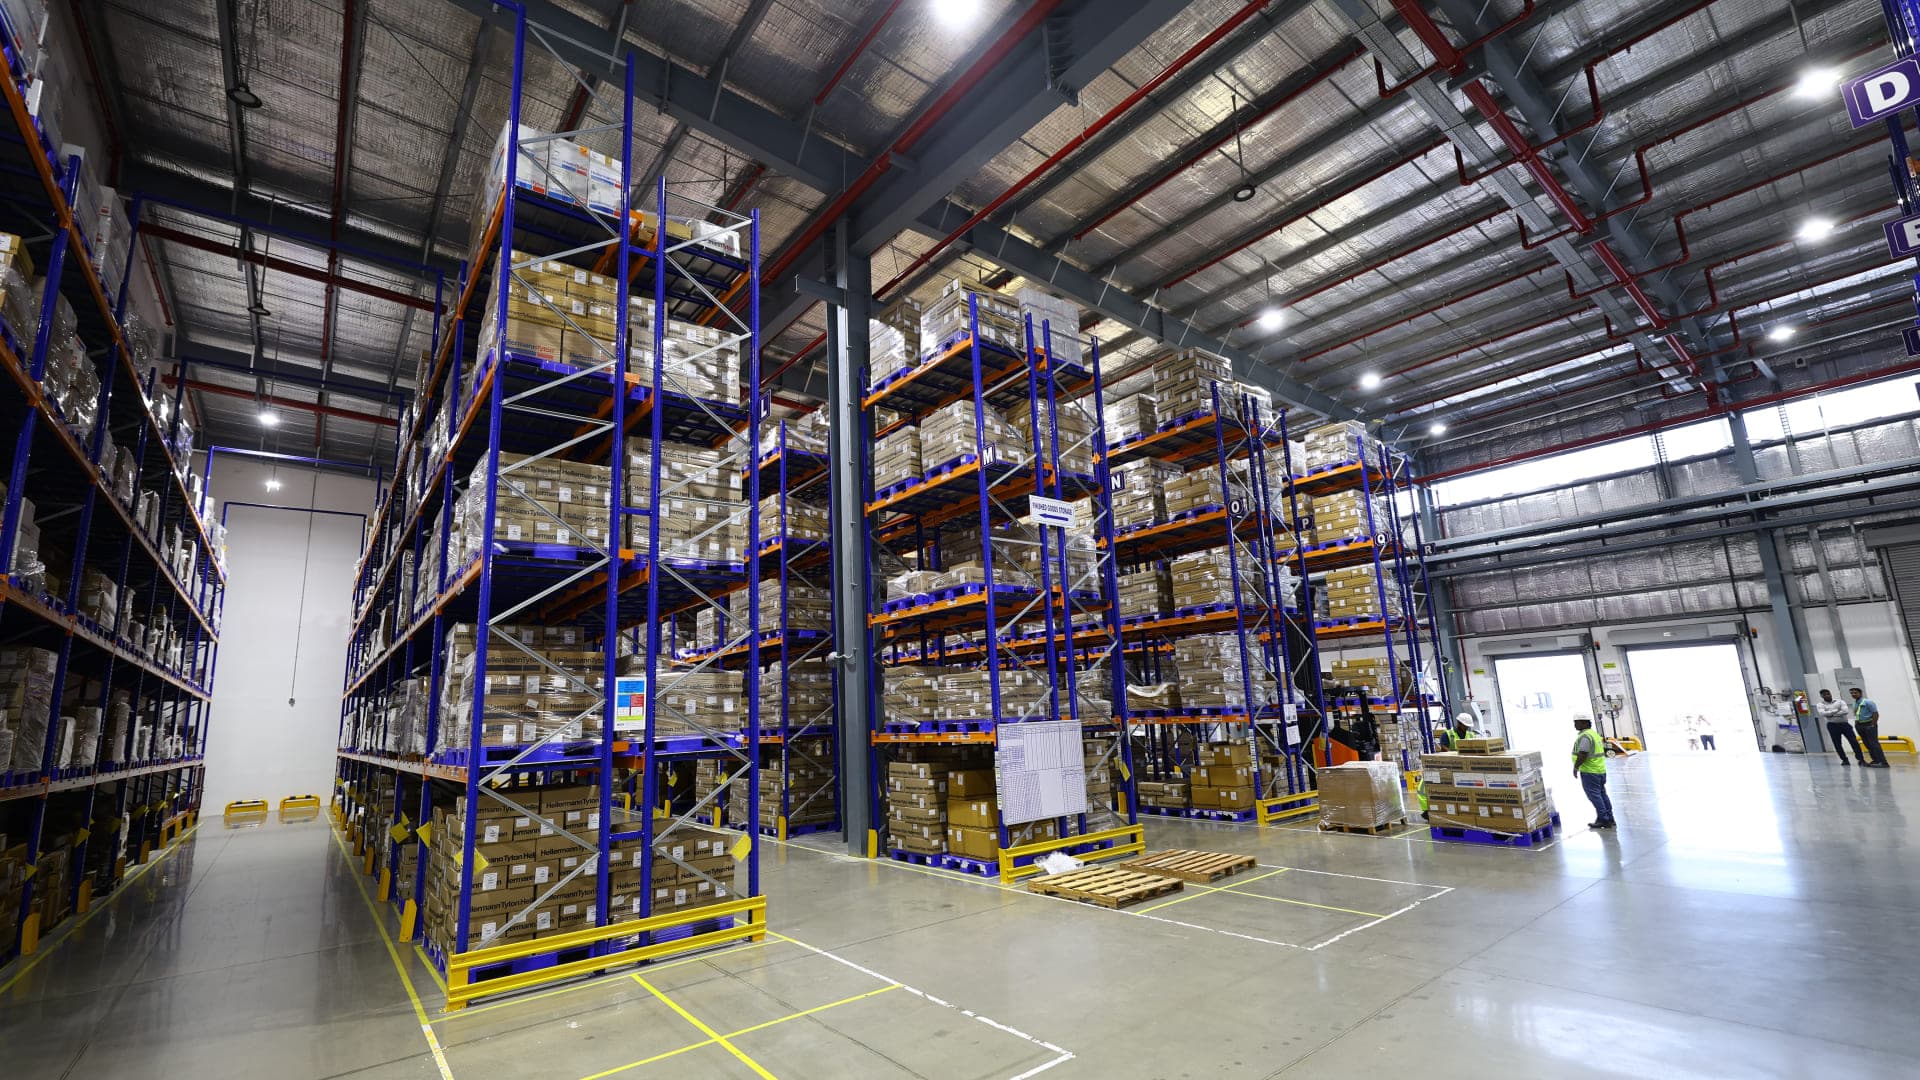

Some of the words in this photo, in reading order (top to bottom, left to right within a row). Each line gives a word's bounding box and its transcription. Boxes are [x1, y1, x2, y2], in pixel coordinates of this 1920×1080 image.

[1864, 72, 1910, 113] D
[760, 399, 768, 418] L
[982, 446, 993, 466] M
[1110, 474, 1121, 490] N
[1302, 517, 1309, 529] P
[1424, 545, 1432, 554] R
